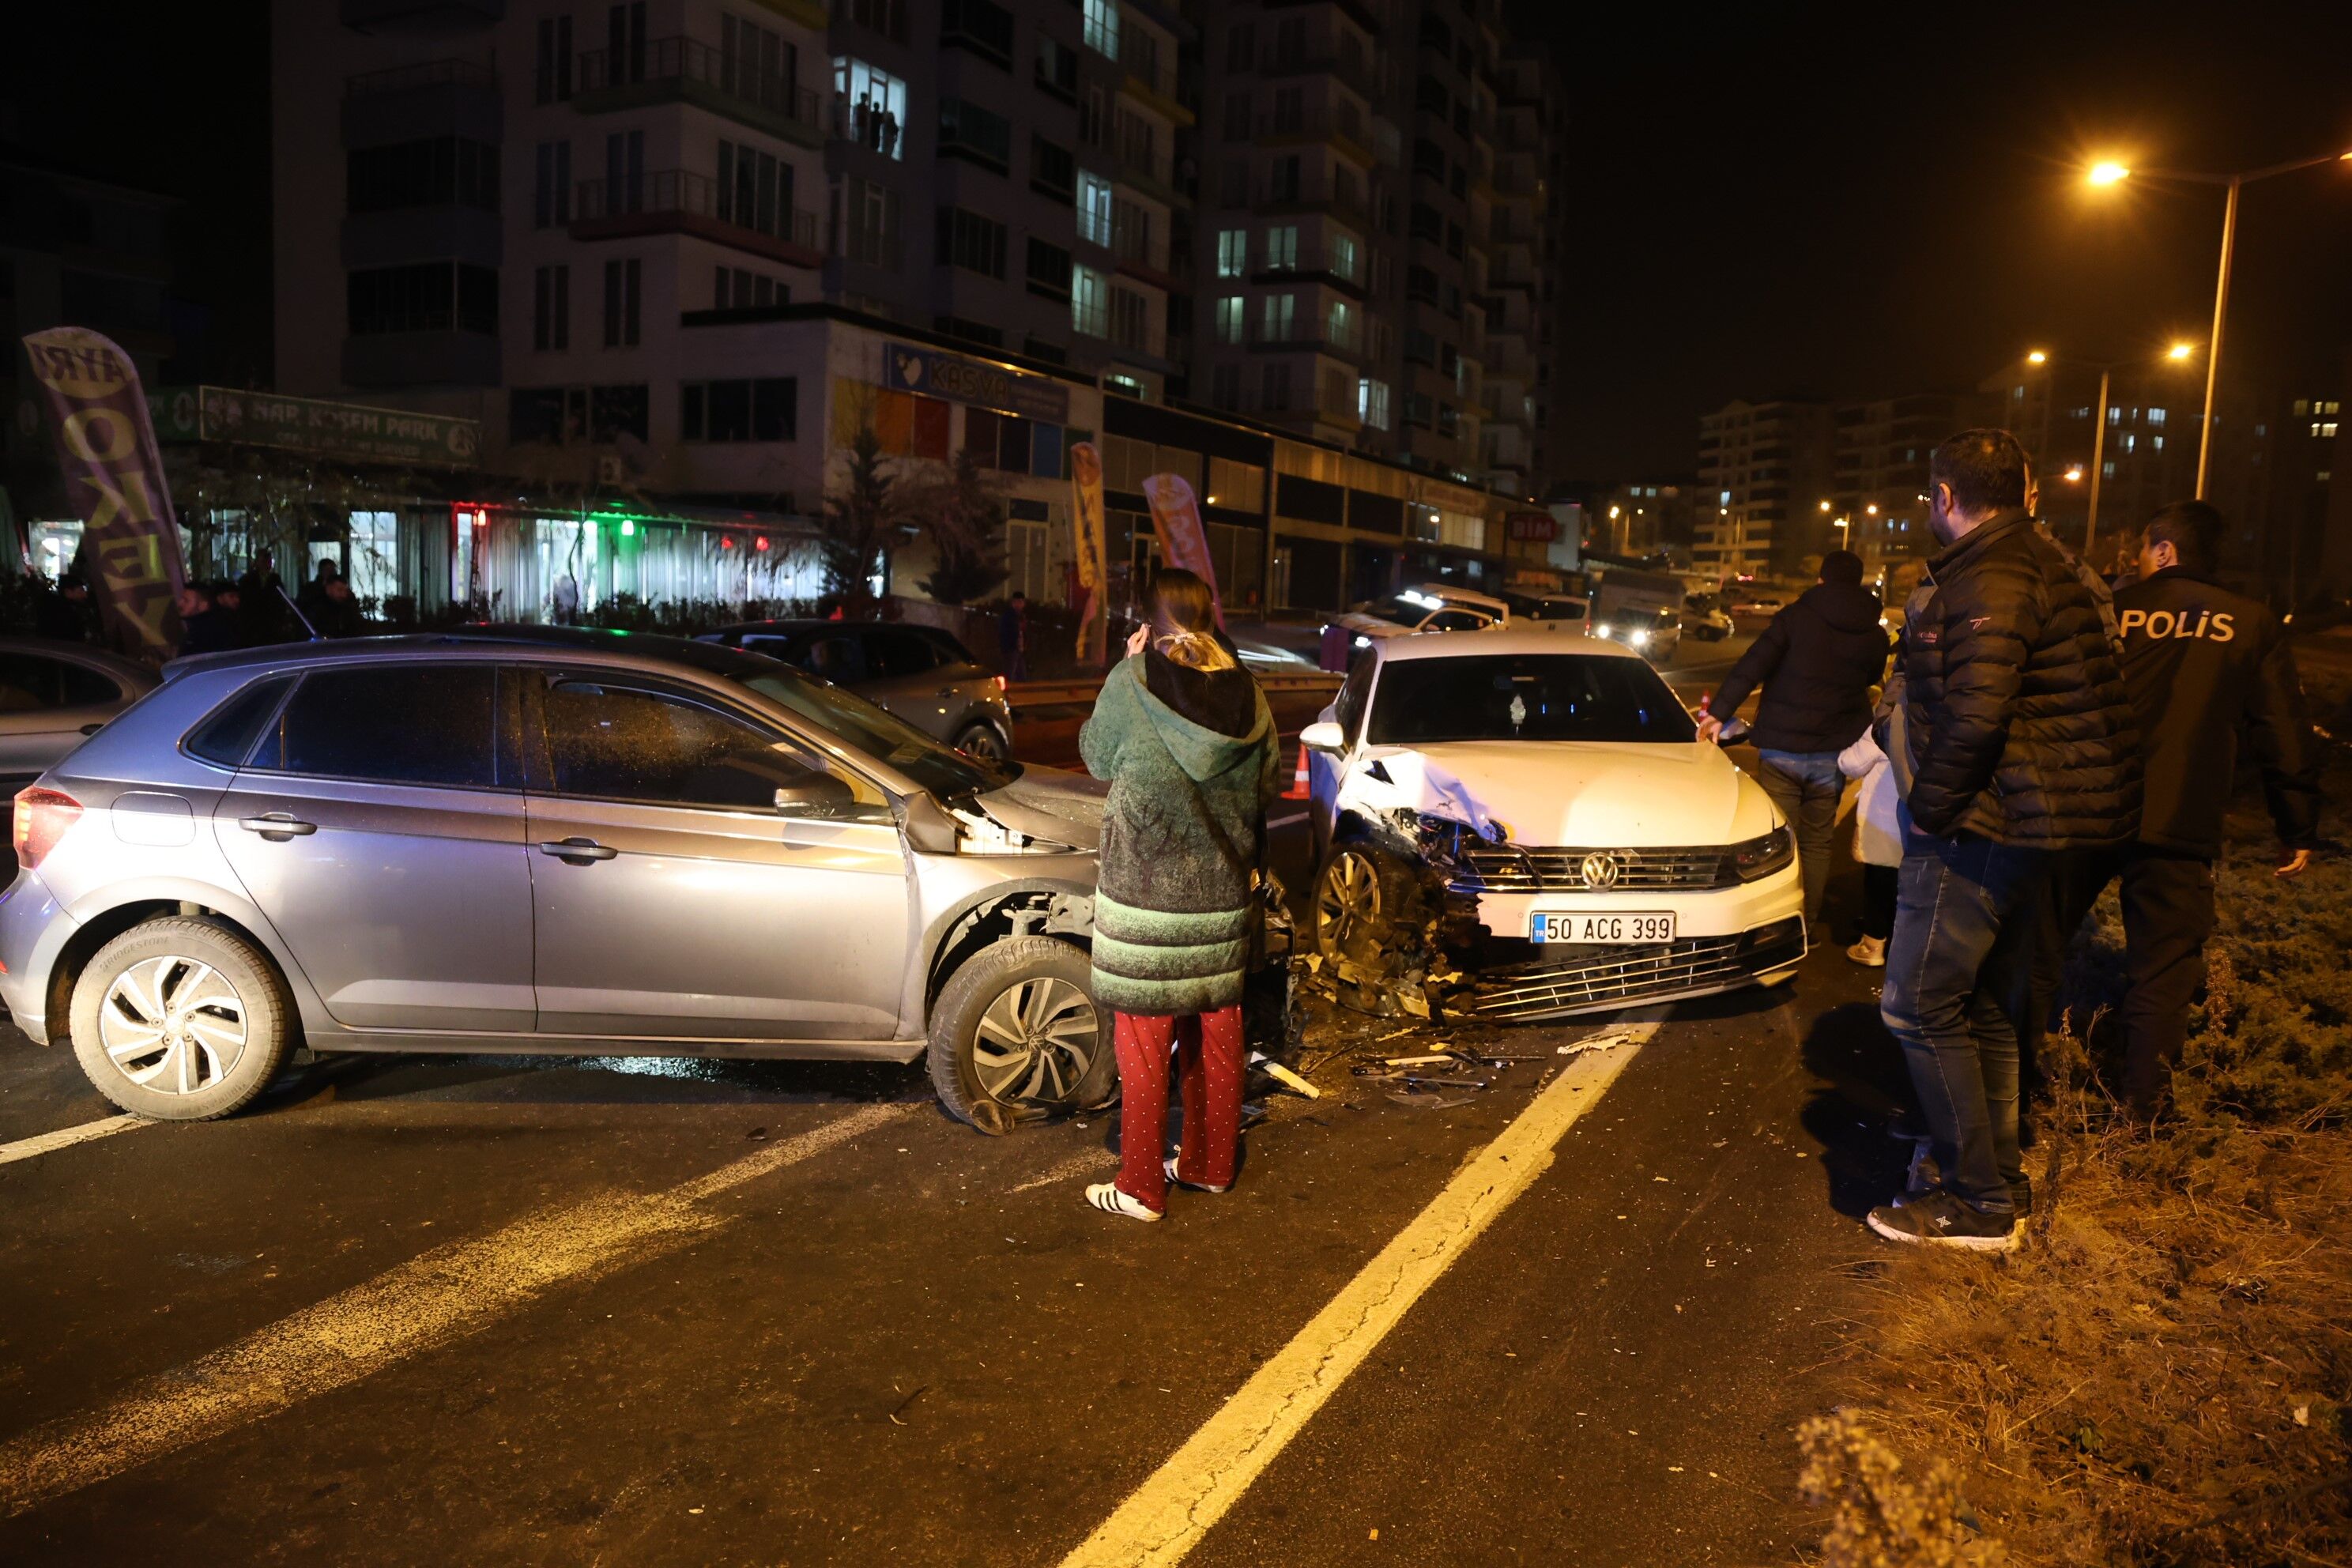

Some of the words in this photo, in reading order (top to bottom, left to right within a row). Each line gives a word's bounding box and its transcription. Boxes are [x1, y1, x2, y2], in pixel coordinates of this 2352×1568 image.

[1547, 918, 1572, 940] 50
[1584, 918, 1622, 940] ACG
[1632, 918, 1670, 940] 399
